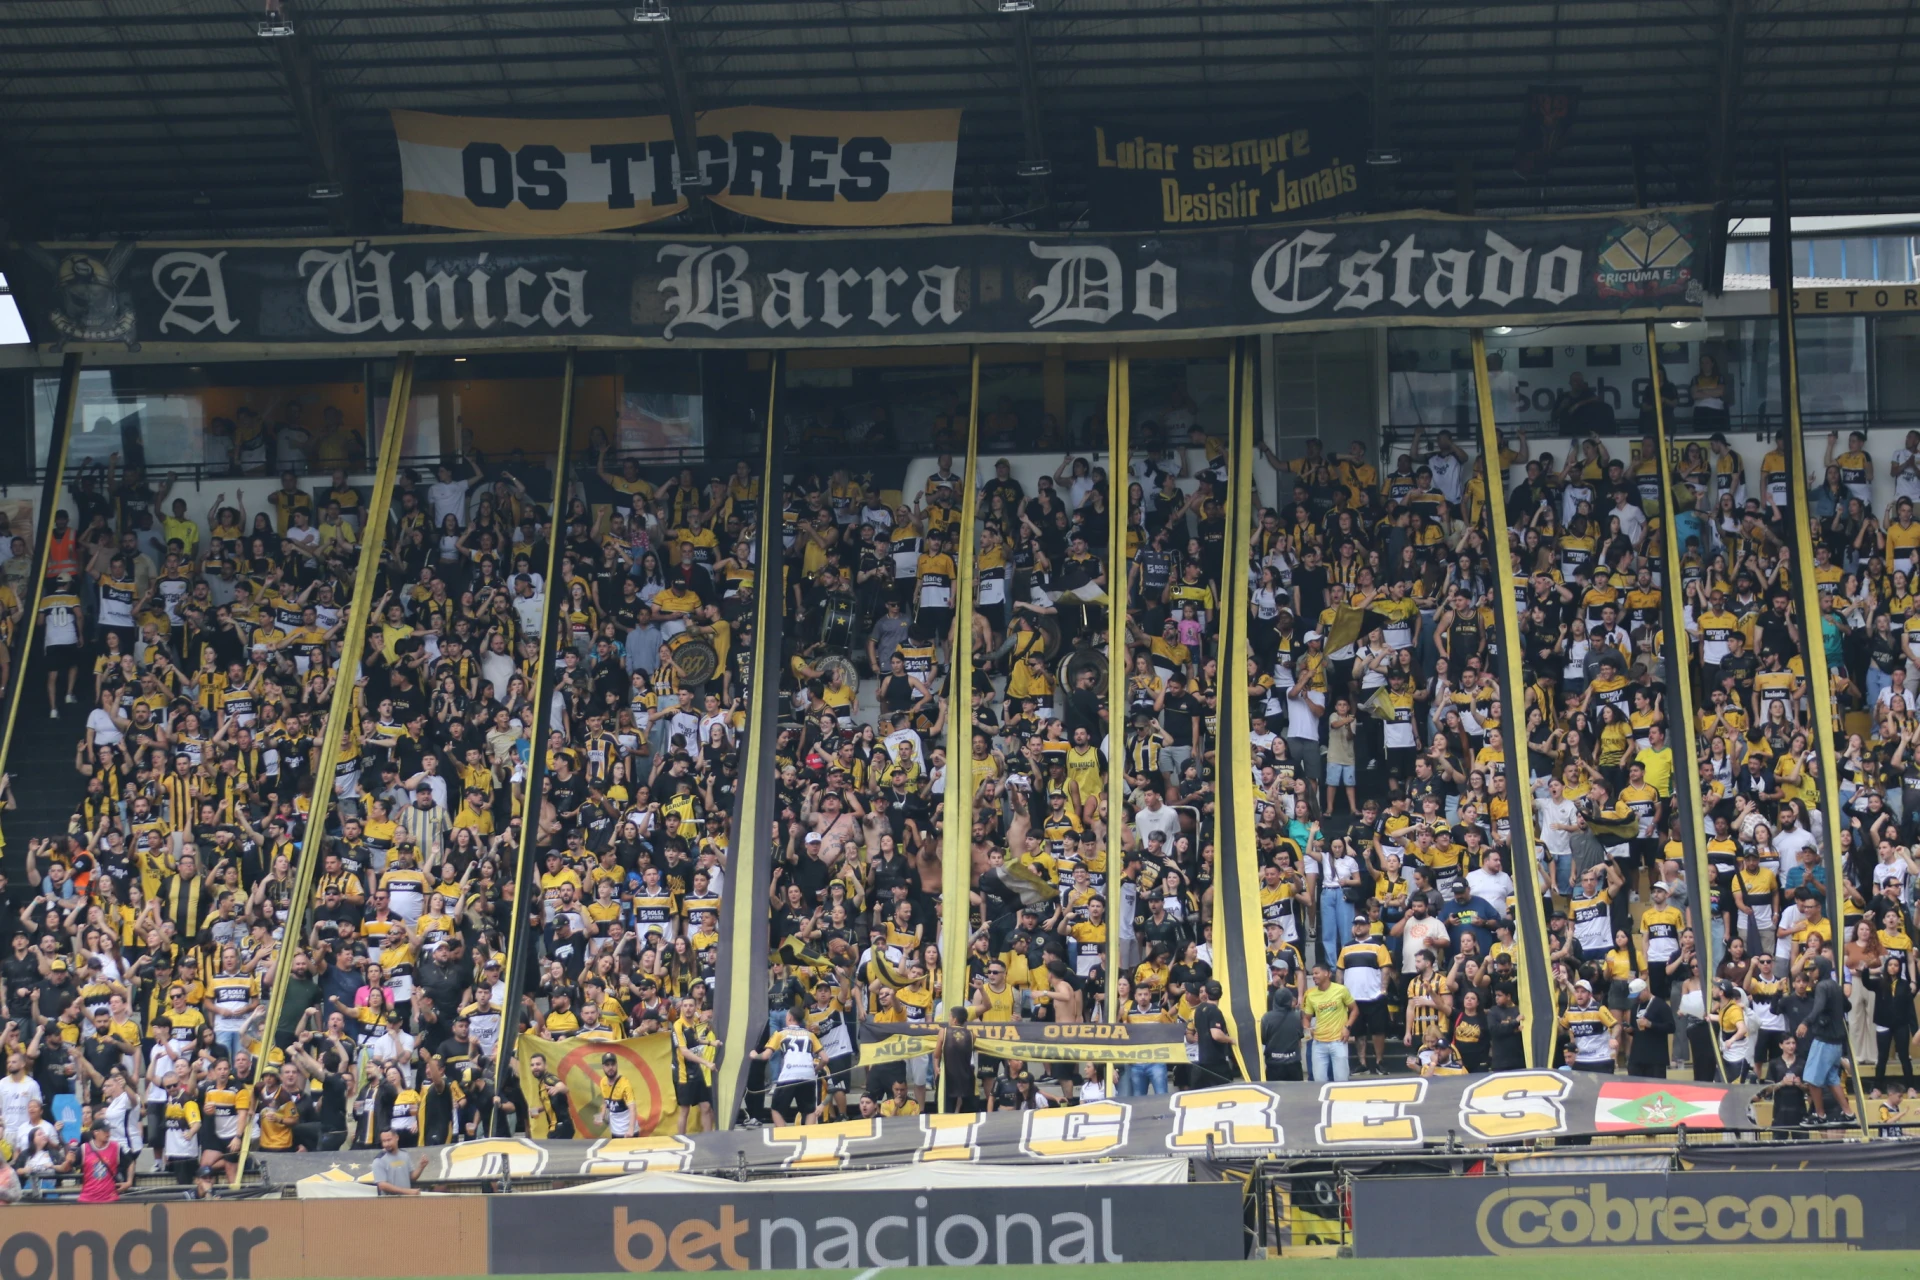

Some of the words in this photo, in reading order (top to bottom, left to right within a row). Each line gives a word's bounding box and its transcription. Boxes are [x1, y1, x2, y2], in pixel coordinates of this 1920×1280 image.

[462, 141, 567, 210] OS
[590, 131, 892, 209] TIGRES
[1094, 126, 1178, 170] Lutar
[1193, 128, 1310, 175] sempre
[1161, 178, 1260, 222] Desistir
[1271, 157, 1357, 213] Jamais
[152, 250, 240, 335] A
[656, 243, 963, 340] Barra
[1028, 240, 1177, 329] Do
[1251, 228, 1583, 314] Estado
[1597, 269, 1660, 283] CRICIÚMA
[51, 607, 67, 626] 10
[787, 1035, 809, 1053] 37
[966, 1025, 1020, 1040] TUA
[997, 1042, 1170, 1061] EVANTAMOS
[763, 1070, 1574, 1169] TIGRES
[1, 1203, 268, 1280] onder
[613, 1195, 1124, 1271] betnacional
[1502, 1183, 1863, 1244] cobrecom
